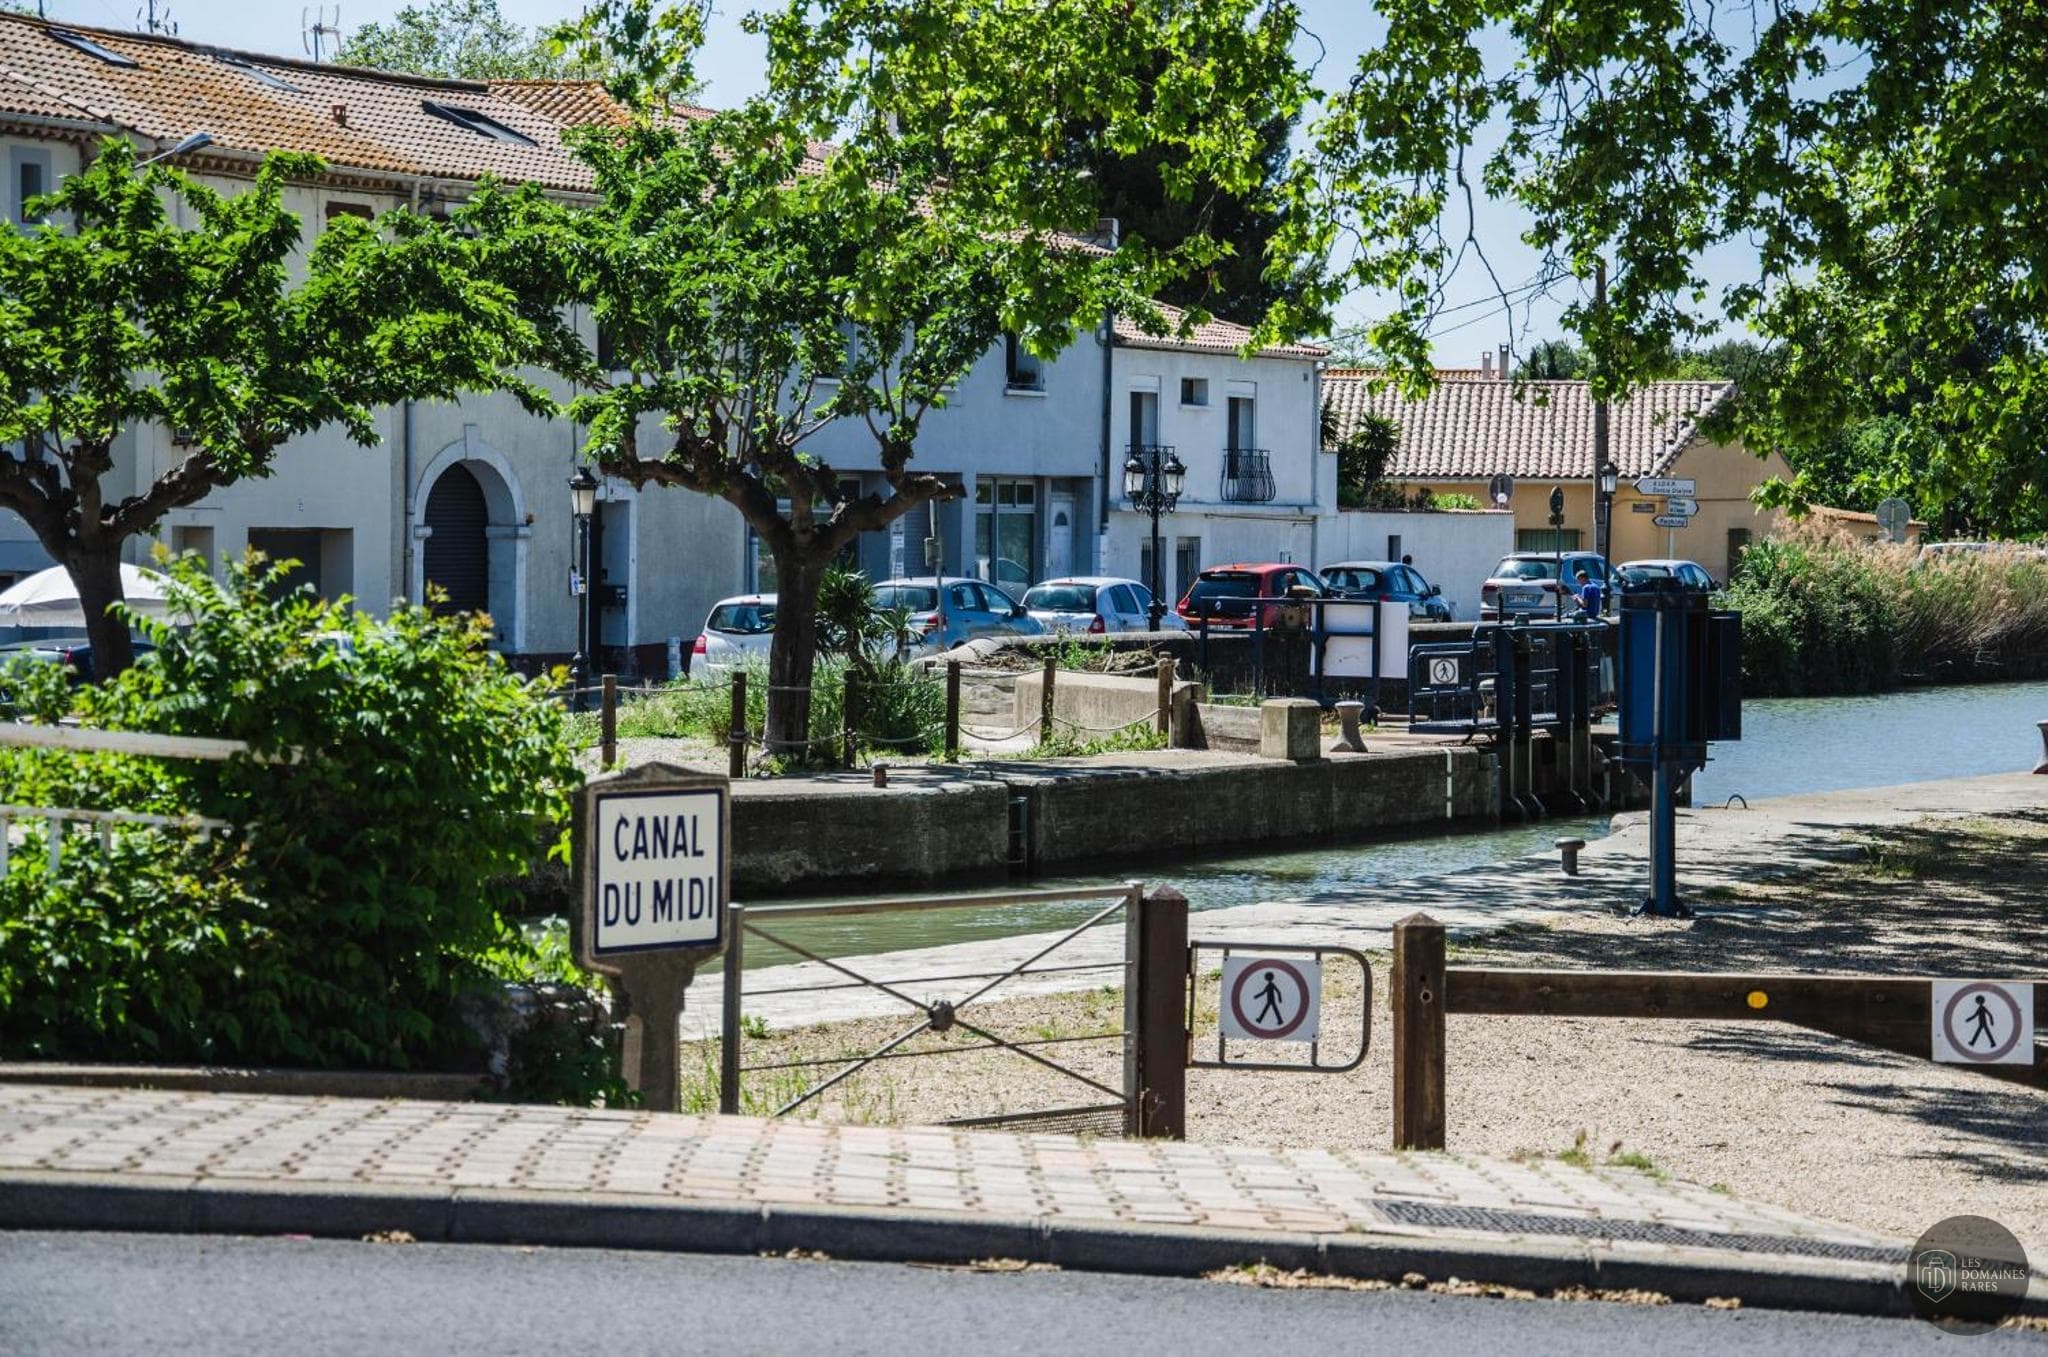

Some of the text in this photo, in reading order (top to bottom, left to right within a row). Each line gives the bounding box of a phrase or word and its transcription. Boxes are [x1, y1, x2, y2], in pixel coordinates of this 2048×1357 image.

[614, 814, 705, 862] CANAL
[603, 876, 714, 928] DU MIDI
